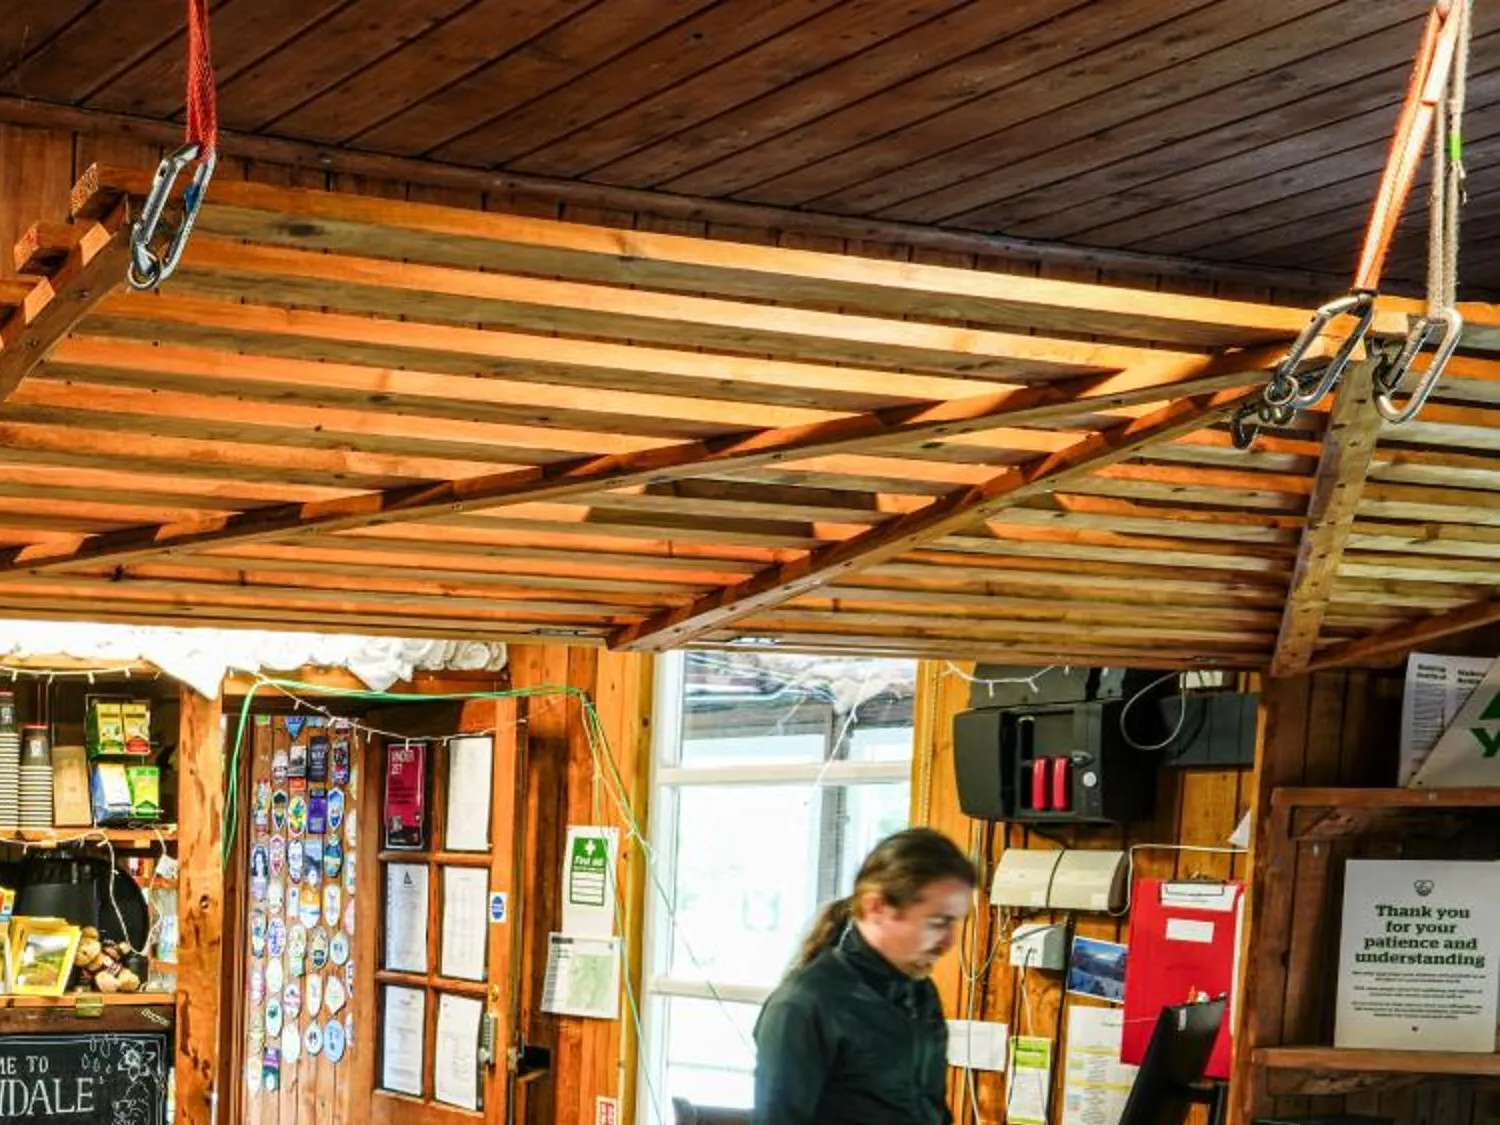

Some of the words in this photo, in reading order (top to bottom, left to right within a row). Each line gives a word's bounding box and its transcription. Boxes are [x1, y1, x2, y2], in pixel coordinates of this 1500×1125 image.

[1374, 904, 1432, 918] Thank
[1435, 908, 1471, 921] you
[1385, 921, 1412, 934] for
[1415, 922, 1458, 936] your
[1363, 936, 1440, 951] patience
[1443, 937, 1478, 951] and
[1354, 951, 1486, 969] understanding
[26, 1055, 49, 1074] TO
